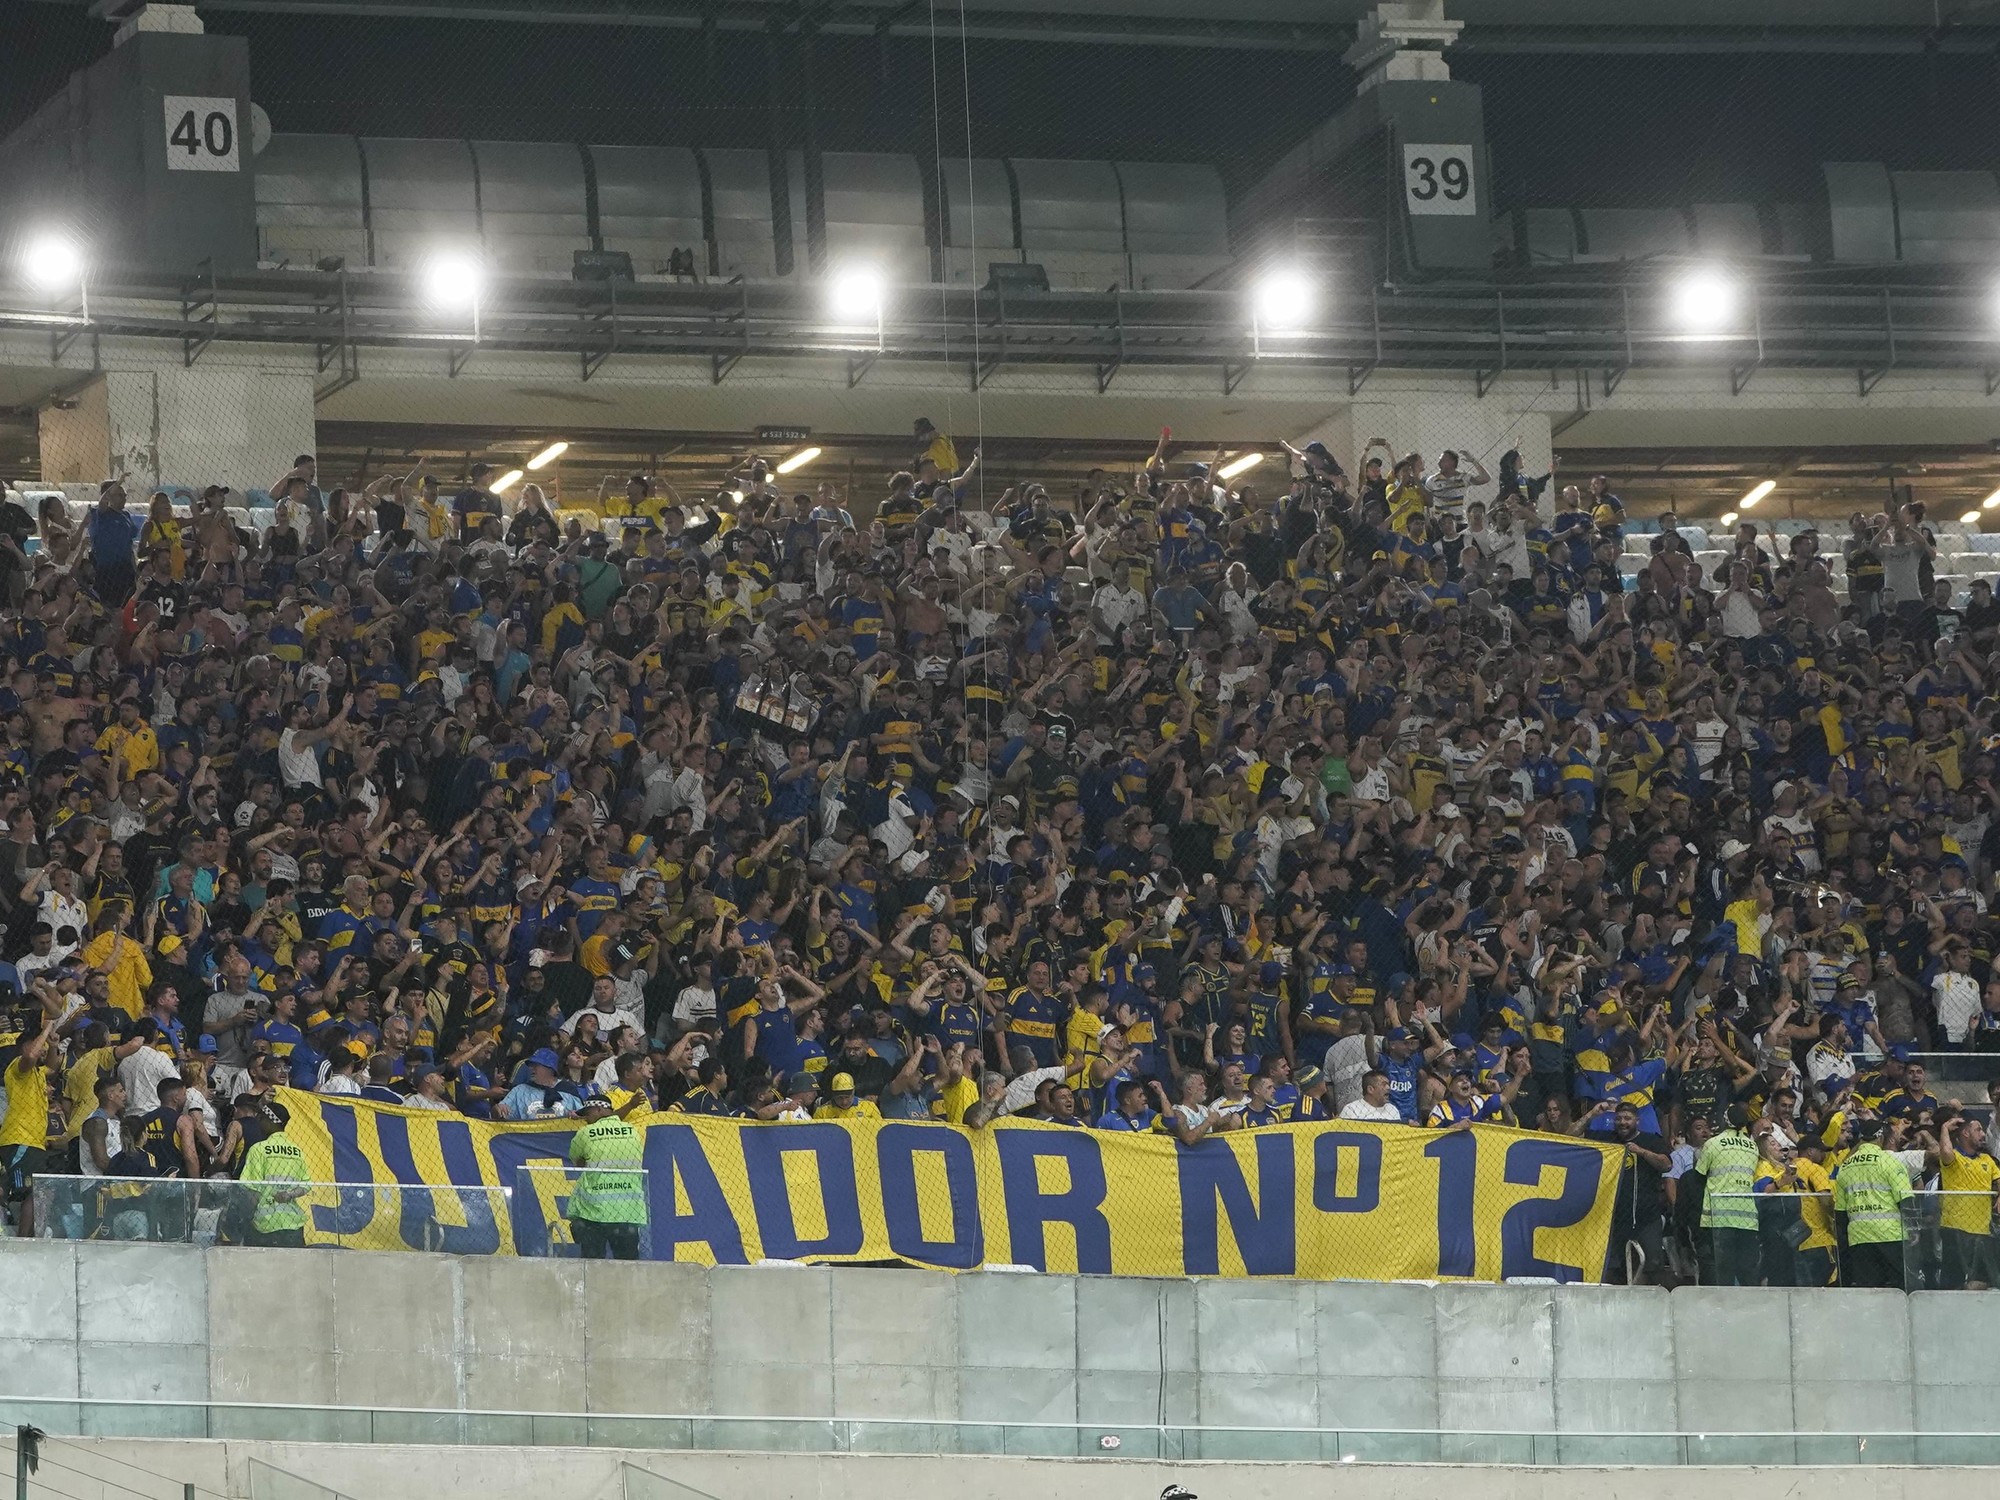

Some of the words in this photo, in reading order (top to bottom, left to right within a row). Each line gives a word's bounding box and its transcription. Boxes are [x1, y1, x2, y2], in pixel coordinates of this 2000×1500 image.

[170, 110, 232, 157] 40
[1410, 157, 1469, 201] 39
[157, 596, 174, 617] 12
[588, 1126, 632, 1138] SUNSET
[1424, 1131, 1603, 1281] 12
